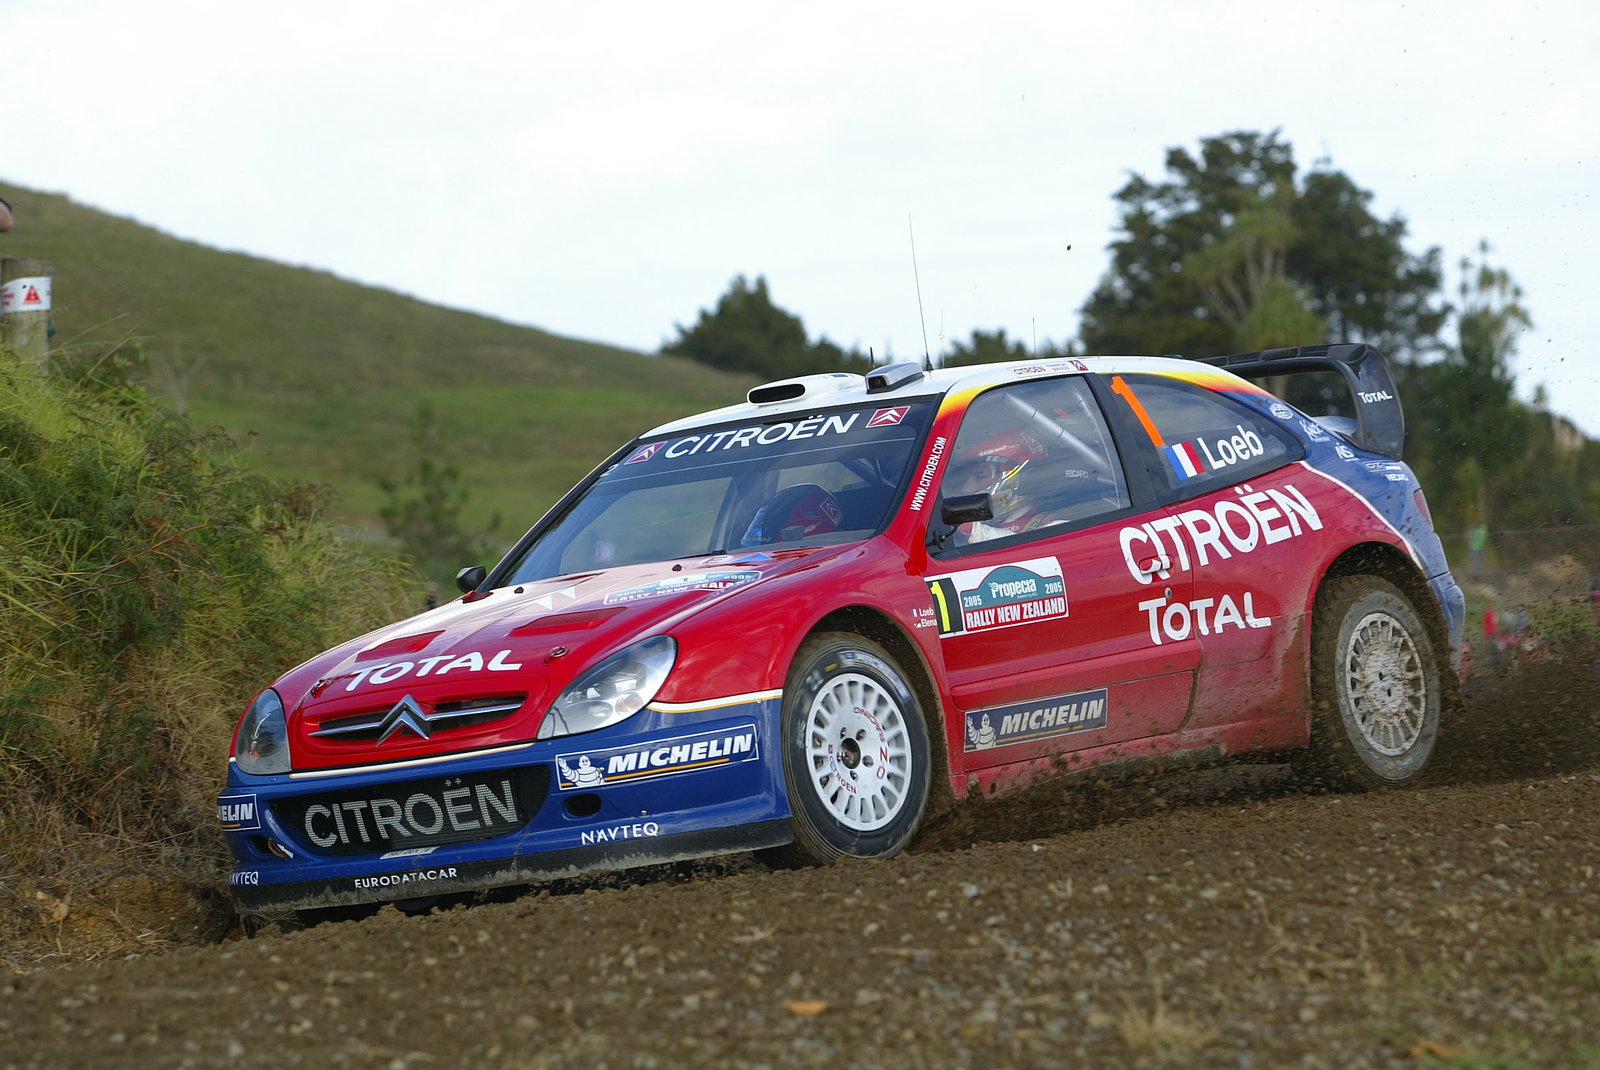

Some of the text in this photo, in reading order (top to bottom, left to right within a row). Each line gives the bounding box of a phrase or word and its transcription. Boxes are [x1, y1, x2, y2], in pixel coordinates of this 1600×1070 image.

[1110, 376, 1165, 447] 1
[1358, 390, 1393, 403] TOTAL
[664, 413, 860, 459] CITROËN
[1197, 424, 1264, 470] Loeb
[909, 436, 947, 512] WWW.CITROEN.COM
[1119, 484, 1324, 585] CITROËN
[930, 581, 951, 632] 1
[963, 595, 983, 607] 2005
[988, 579, 1037, 598] Propecia
[1044, 582, 1063, 594] 2005
[965, 597, 1066, 629] RALLY NEW ZEALAND
[1138, 592, 1272, 645] TOTAL
[345, 649, 523, 692] TOTAL
[999, 699, 1104, 735] MICHELIN
[607, 733, 752, 774] MICHELIN
[218, 803, 253, 821] ELIN
[304, 778, 519, 848] CITROËN
[581, 822, 659, 845] NAVTEQ
[354, 868, 458, 888] EURODATACAR
